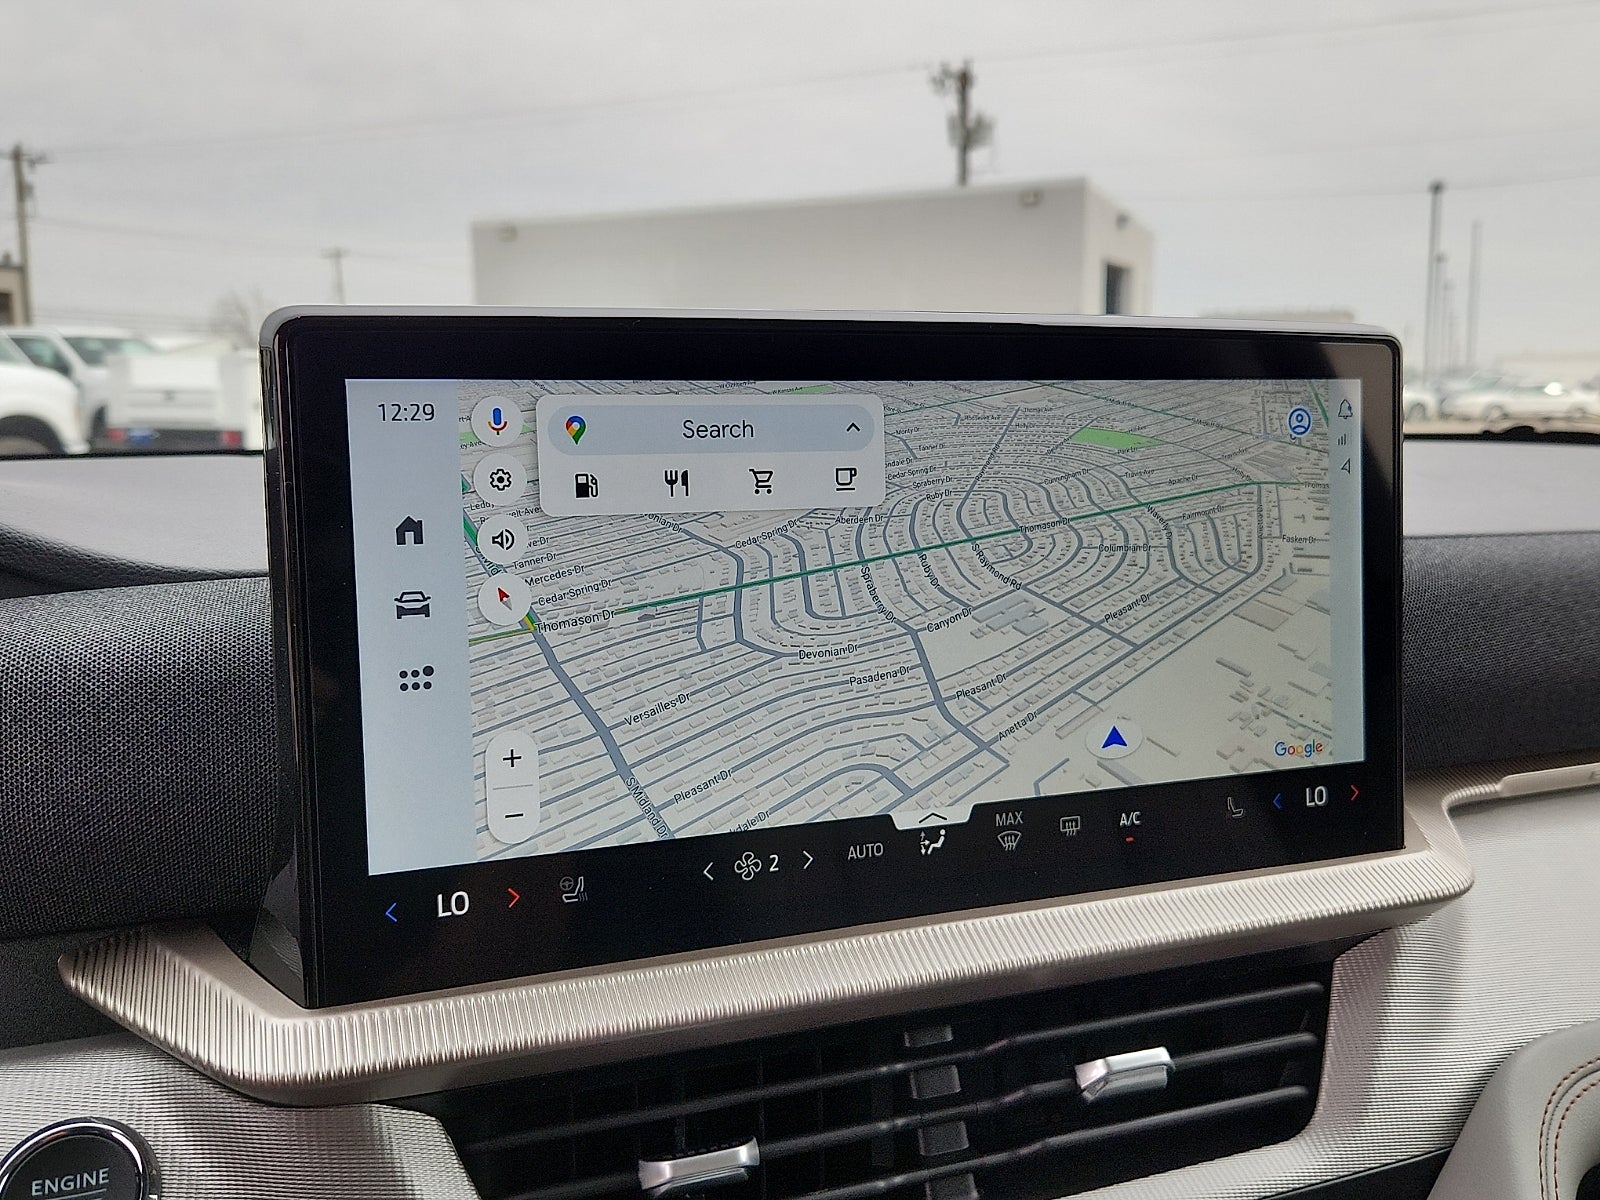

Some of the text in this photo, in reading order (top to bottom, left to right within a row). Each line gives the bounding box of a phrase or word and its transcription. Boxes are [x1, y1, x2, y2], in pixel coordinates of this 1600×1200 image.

[378, 403, 435, 421] 12:29
[682, 419, 754, 438] Search
[975, 441, 1001, 481] Raymond Rd
[887, 465, 937, 480] Cedar Spring Dr
[1081, 468, 1089, 476] Dr
[913, 475, 953, 489] Spraberry Dr
[926, 488, 953, 501] Ruby Dr
[835, 513, 884, 524] Aberdeen Dr
[1147, 504, 1169, 531] Waverly
[1182, 506, 1215, 520] Fairmount
[673, 522, 683, 534] Dr
[735, 519, 799, 549] Cedar Spring Dr
[1019, 517, 1071, 533] Thomason Dr
[539, 536, 550, 546] Dr
[1098, 543, 1152, 552] Columbian Dr
[1282, 535, 1308, 543] Fasken
[513, 552, 557, 570] Tanner Dr
[971, 543, 1022, 591] S Raymond Rd
[525, 563, 586, 586] Mercedes Dr
[919, 553, 941, 590] Ruby Dr
[538, 577, 612, 606] Cedar Spring Dr
[860, 566, 897, 624] Spraberry Dr
[1104, 593, 1151, 623] Pleasant Dr
[534, 609, 616, 634] Thomason Dr
[926, 606, 973, 633] Canyon Dr
[798, 642, 858, 660] Devonian Dr
[849, 665, 910, 686] Pasadena Dr
[955, 671, 1008, 699] Pleasant Dr
[624, 691, 691, 727] Versailles Dr
[998, 710, 1039, 741] Anetta Dr
[1275, 739, 1323, 757] Google
[674, 767, 733, 804] Pleasant Dr
[1306, 785, 1327, 807] LO
[625, 776, 669, 839] S Midland Dr
[757, 808, 771, 823] Dr
[995, 811, 1024, 827] MAX
[1120, 811, 1142, 827] A/C
[847, 842, 884, 860] AUTO
[768, 854, 779, 872] 2
[437, 890, 470, 918] LO
[31, 1167, 110, 1196] ENGINE
